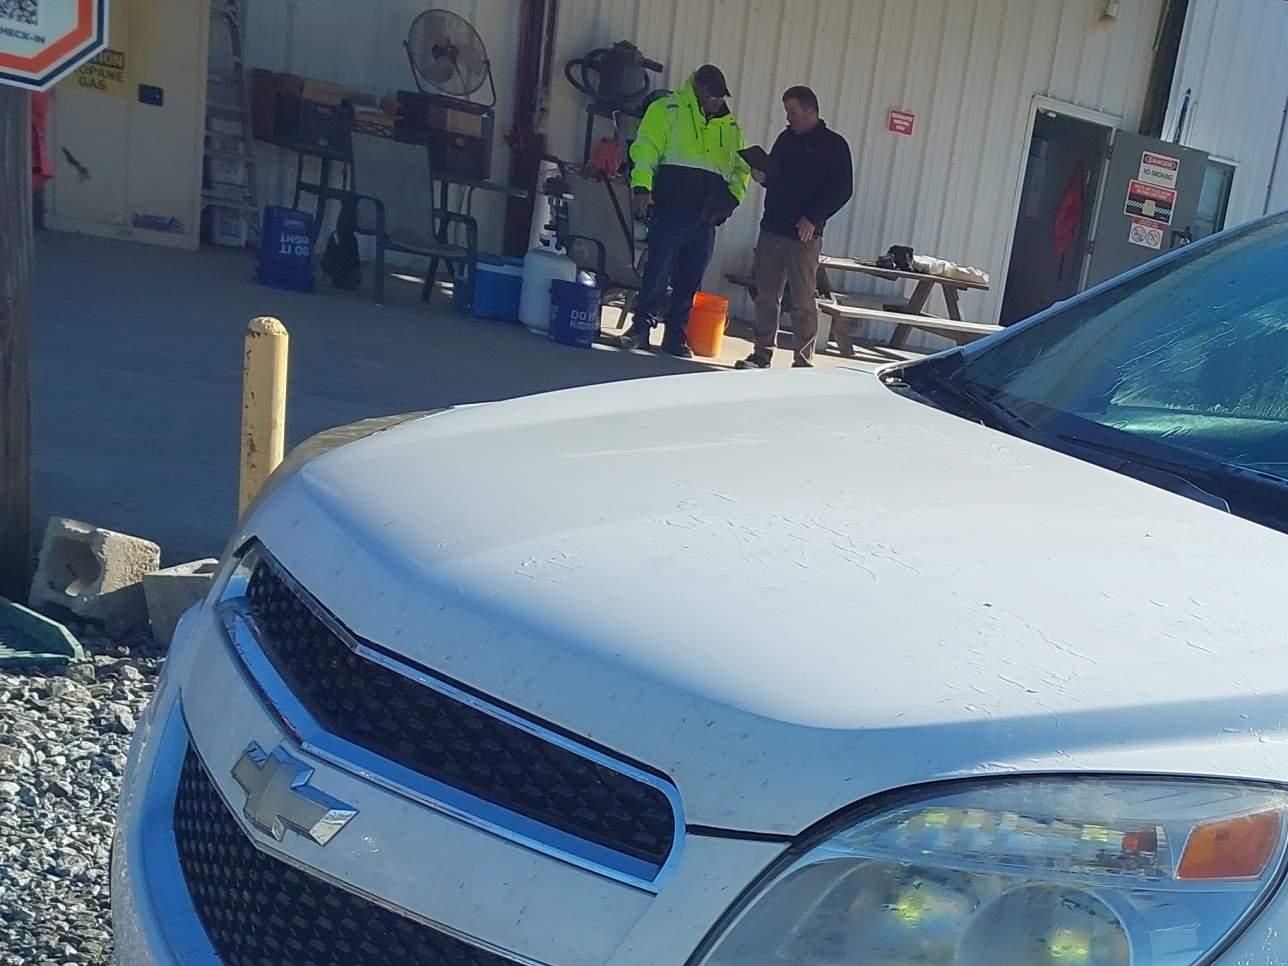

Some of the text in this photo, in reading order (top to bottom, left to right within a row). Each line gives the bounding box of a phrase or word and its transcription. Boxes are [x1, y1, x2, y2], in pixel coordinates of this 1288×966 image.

[0, 27, 46, 44] HECK-IN
[75, 64, 123, 82] OPANE
[79, 76, 106, 89] GAS
[1143, 168, 1151, 176] NO
[279, 242, 310, 257] DO IT
[570, 310, 587, 321] DO
